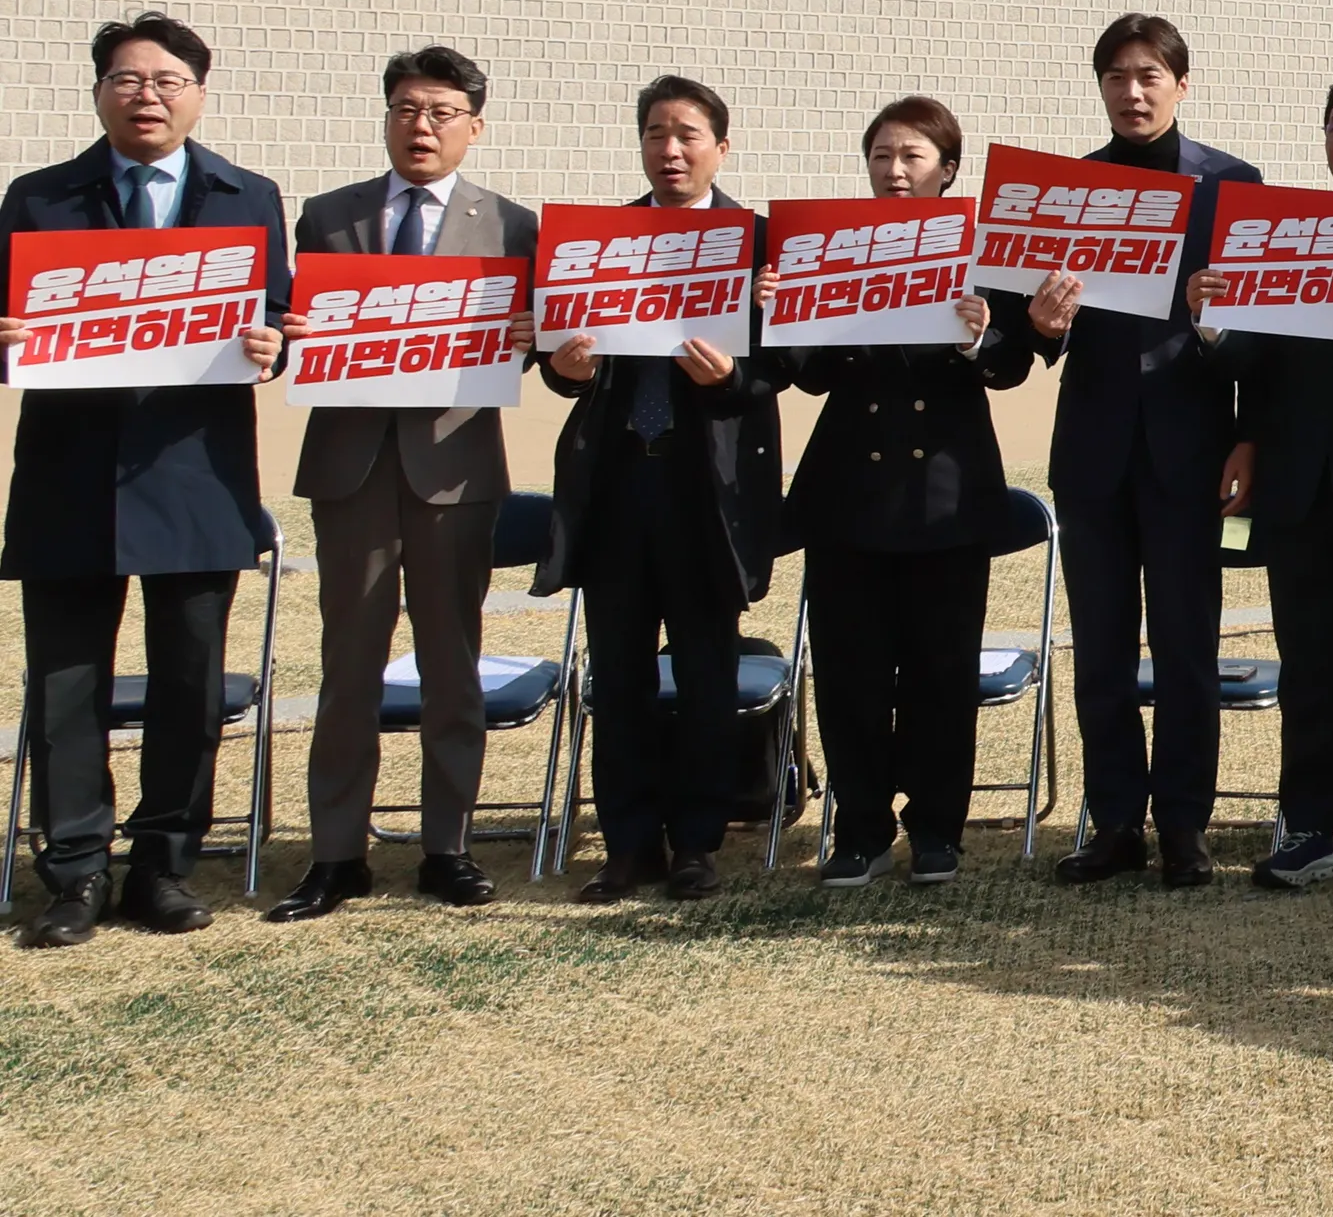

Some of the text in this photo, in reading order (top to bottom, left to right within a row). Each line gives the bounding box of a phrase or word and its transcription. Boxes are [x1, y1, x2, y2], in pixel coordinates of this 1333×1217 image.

[989, 183, 1182, 227] 윤석열을
[547, 226, 744, 281] 윤석열을
[778, 214, 966, 275] 윤석열을
[976, 232, 1178, 274] 파면하라!
[24, 245, 256, 313] 윤석열을
[306, 275, 517, 332] 윤석열을
[540, 276, 745, 331] 파면하라!
[769, 263, 968, 326] 파면하라!
[17, 297, 259, 366] 파면하라!
[293, 327, 513, 385] 파면하라!
